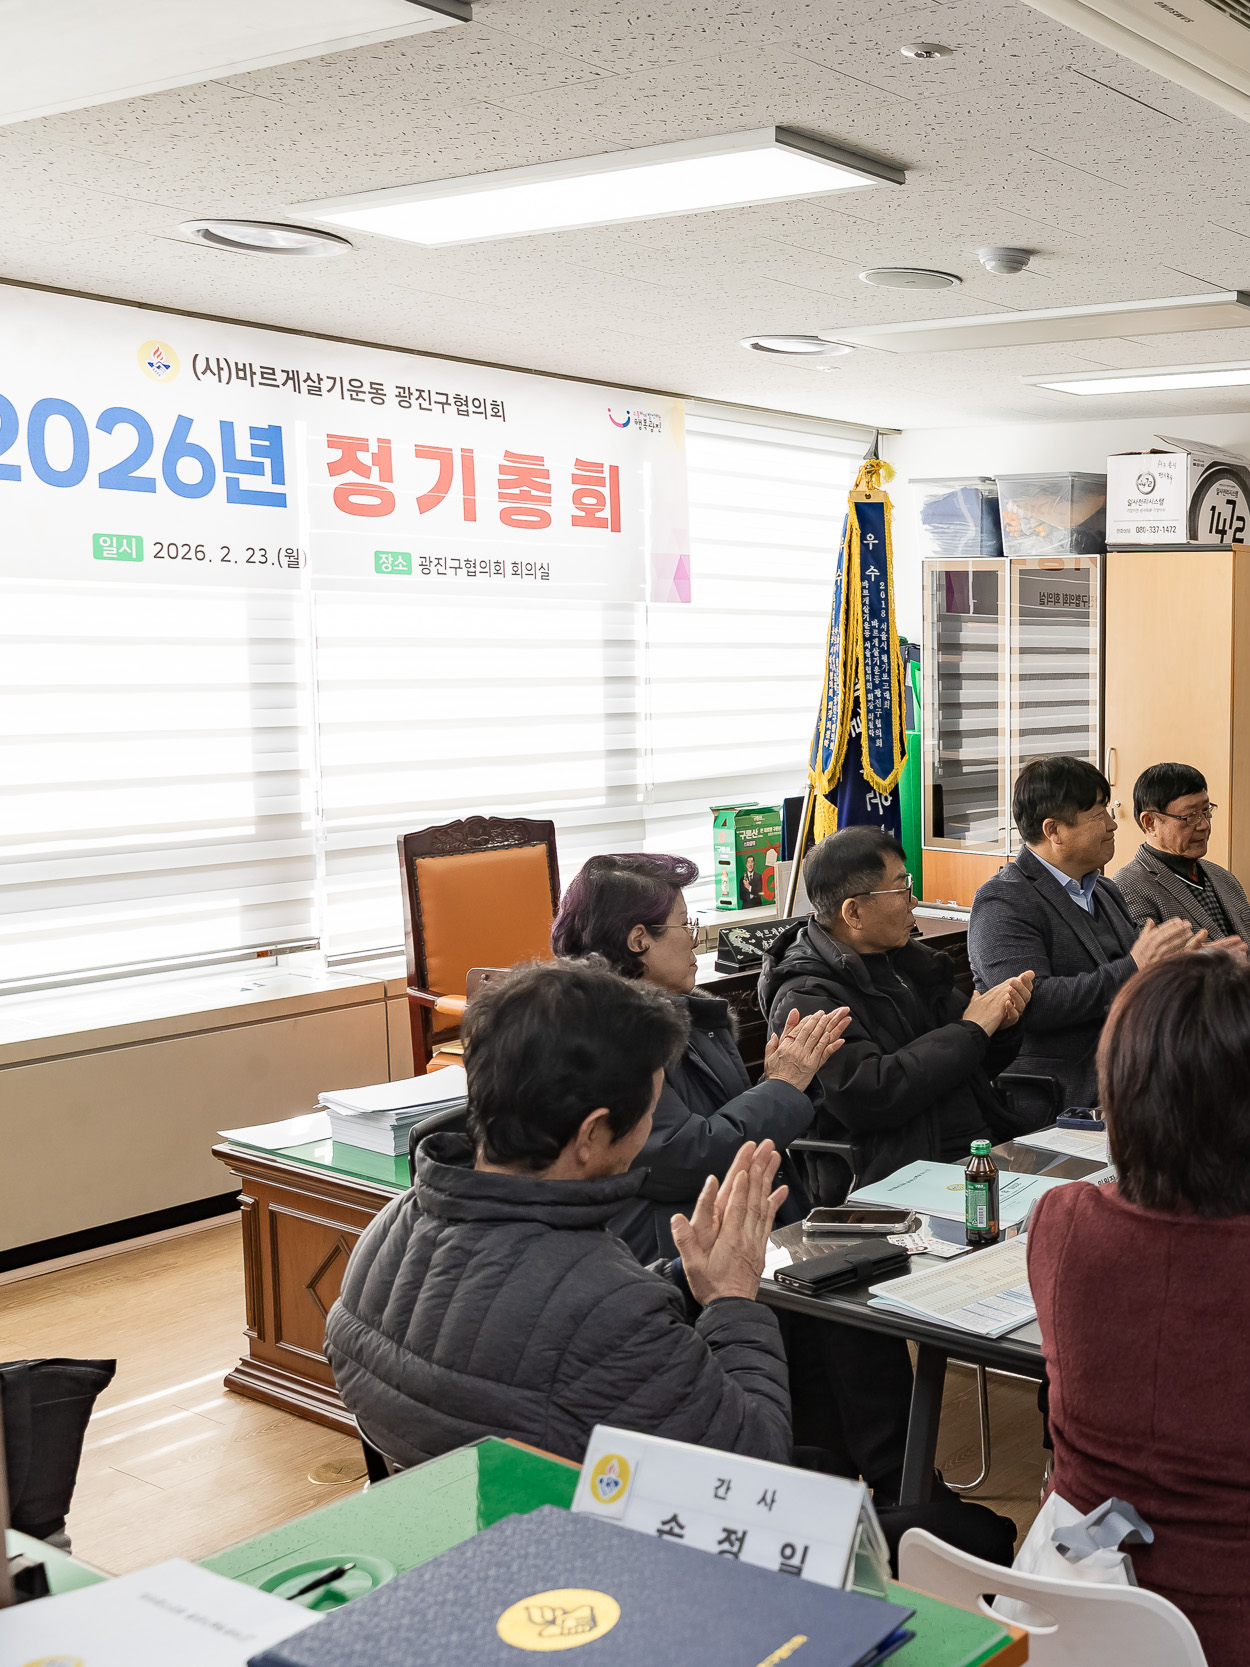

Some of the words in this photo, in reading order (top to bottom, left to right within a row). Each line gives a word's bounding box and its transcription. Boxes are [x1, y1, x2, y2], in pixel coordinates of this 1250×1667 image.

[192, 354, 387, 405] (사)바르게살기운동
[395, 385, 506, 422] 광진구협의회
[1136, 525, 1177, 534] 080-337-1472
[1208, 498, 1246, 544] 1472
[99, 536, 137, 558] 일시
[153, 542, 212, 562] 2026.
[220, 546, 238, 564] 2.
[379, 553, 409, 572] 장소
[418, 556, 506, 578] 광진구협의회
[511, 561, 550, 581] 회의실
[879, 582, 888, 618] 2018
[880, 622, 888, 650] 서울시
[874, 688, 883, 748] 광진구협의회
